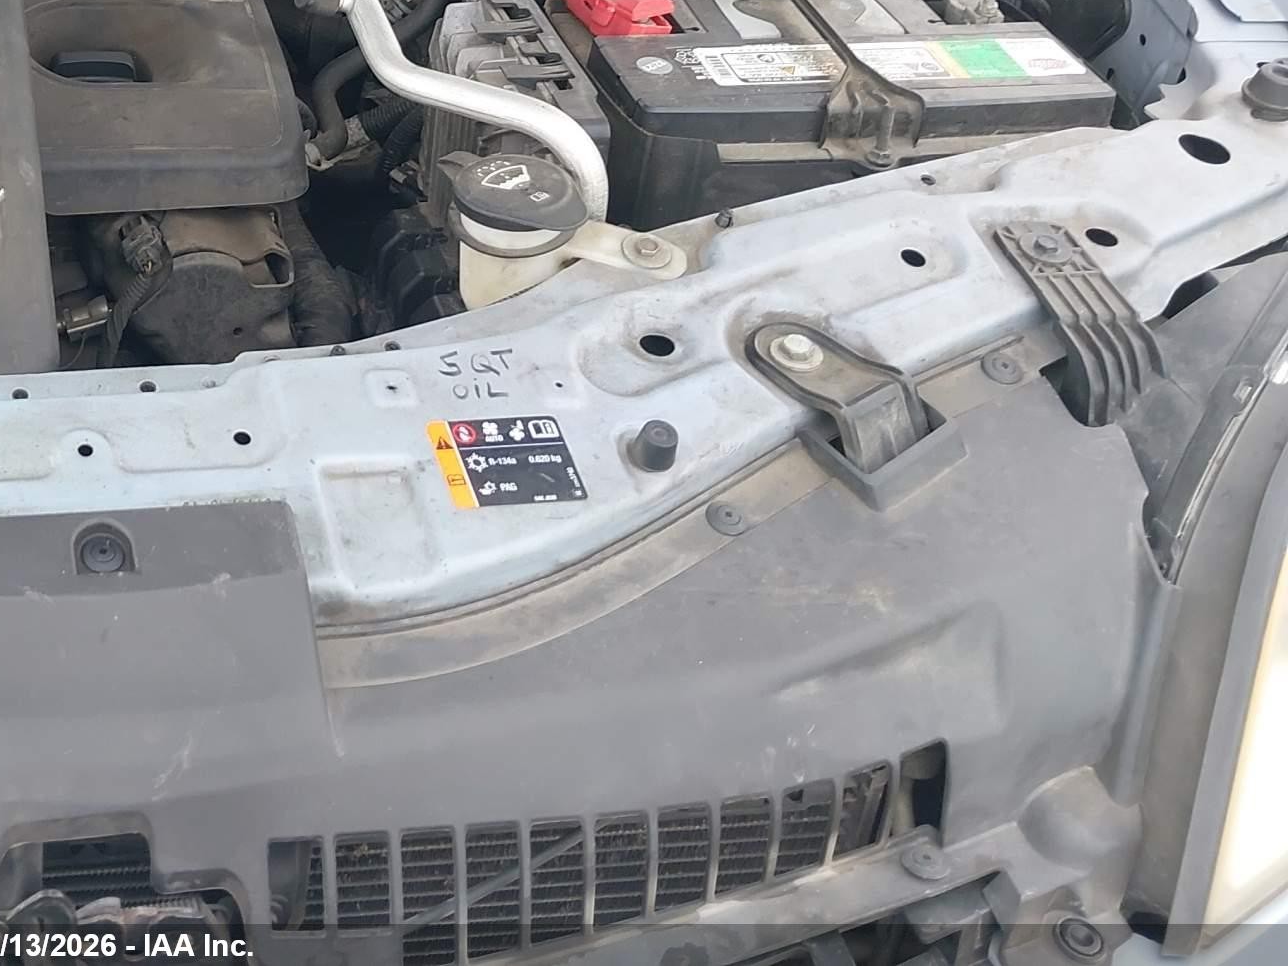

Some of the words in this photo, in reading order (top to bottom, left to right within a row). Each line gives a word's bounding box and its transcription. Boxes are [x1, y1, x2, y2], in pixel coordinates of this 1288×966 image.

[488, 456, 518, 466] R-134a
[550, 454, 563, 464] kg
[499, 482, 518, 492] PAG
